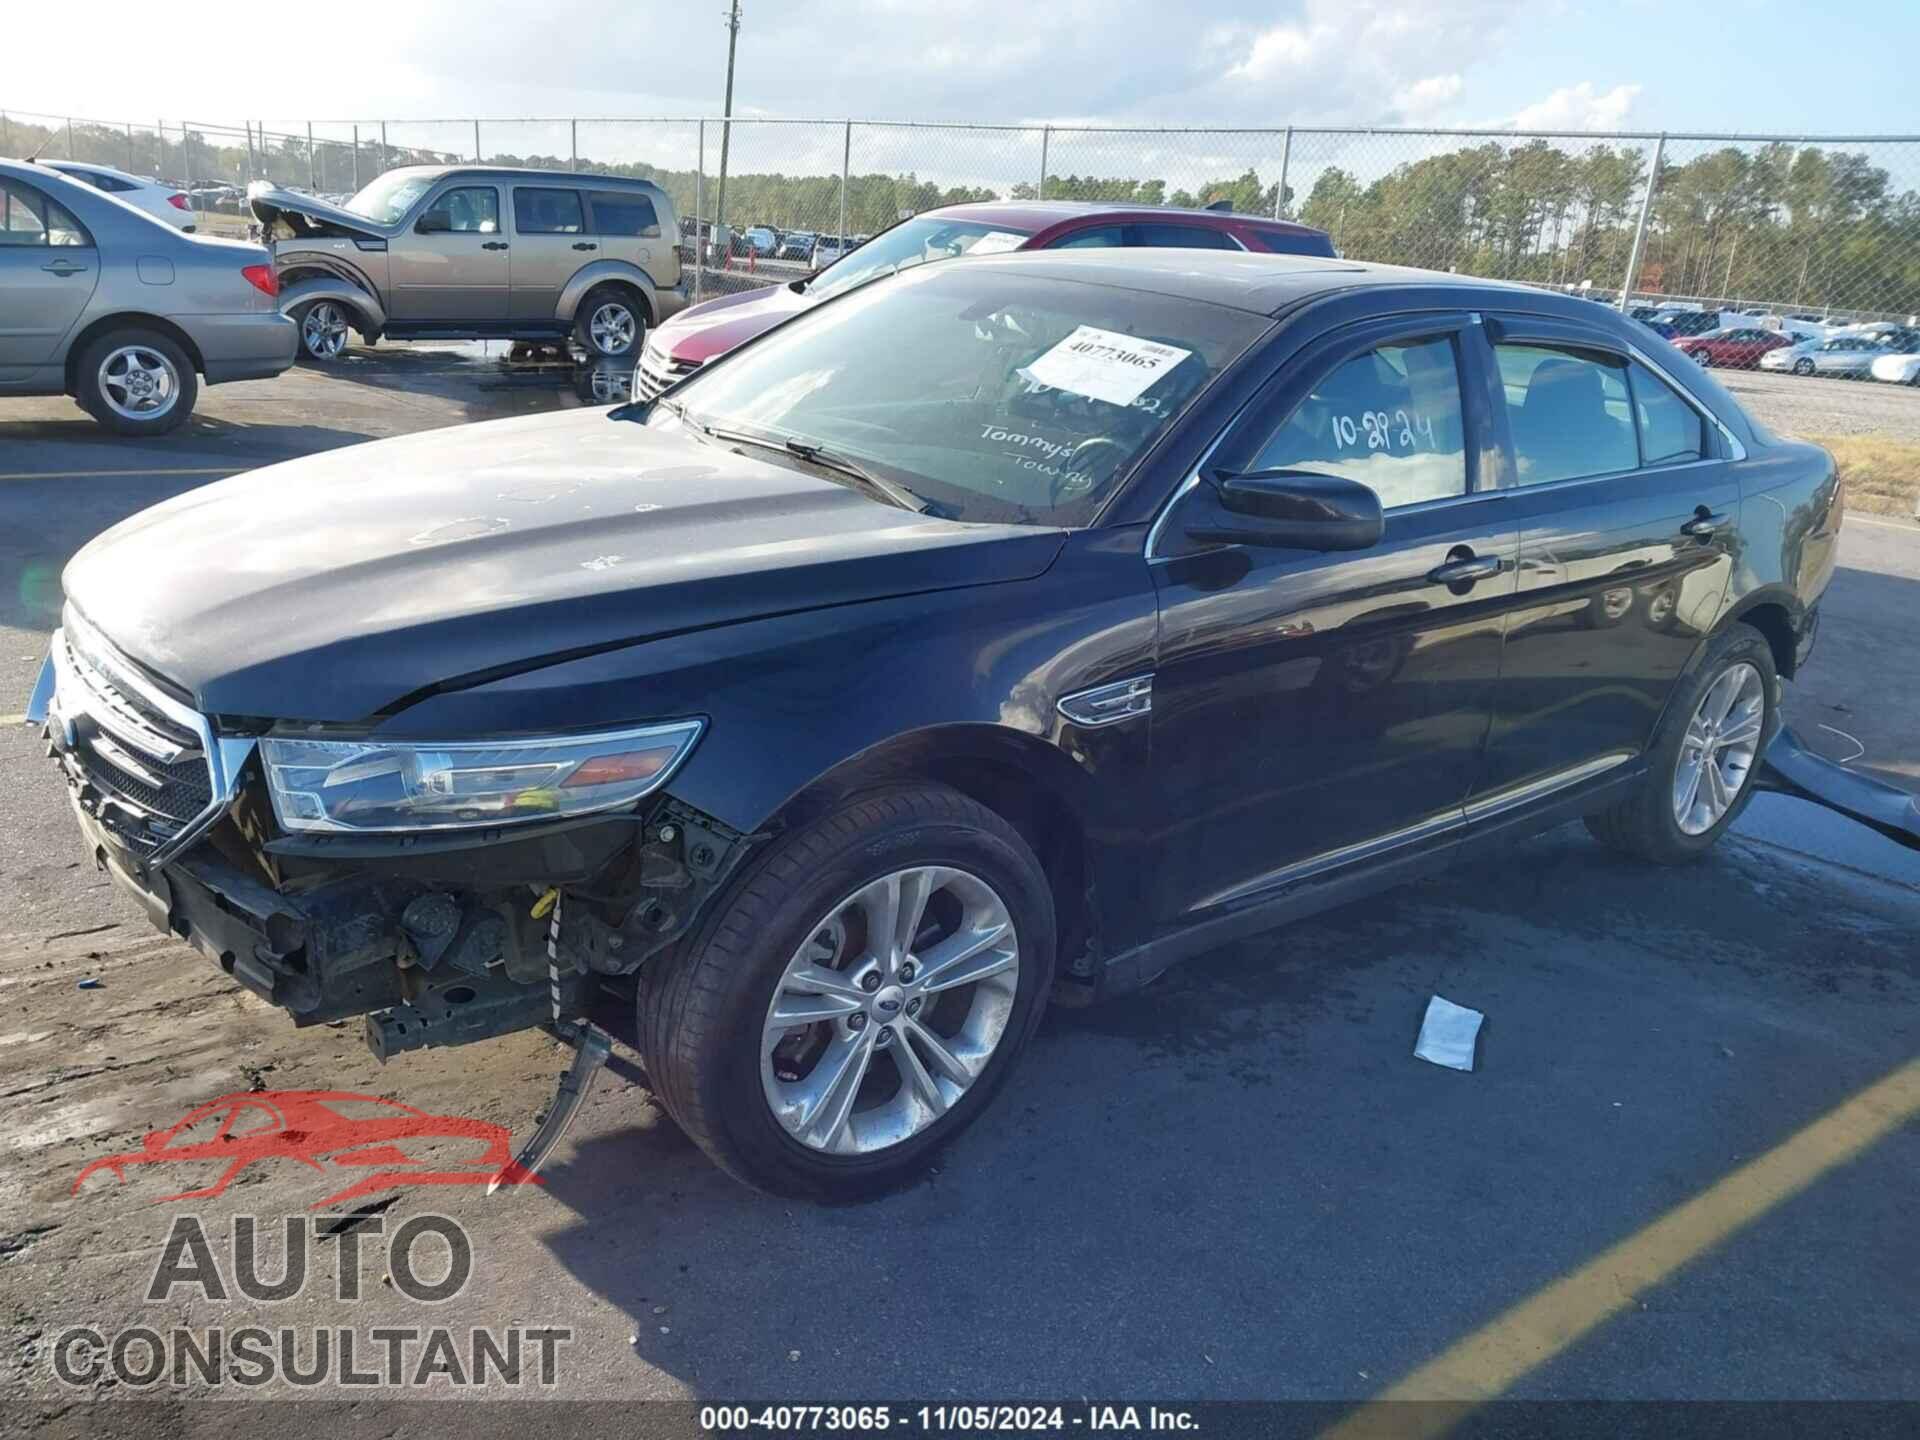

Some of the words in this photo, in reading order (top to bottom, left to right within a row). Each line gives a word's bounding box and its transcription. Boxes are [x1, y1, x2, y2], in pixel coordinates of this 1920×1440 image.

[1070, 341, 1162, 369] 40773065
[1332, 409, 1436, 450] 10-29-24
[1002, 452, 1093, 491] Towng
